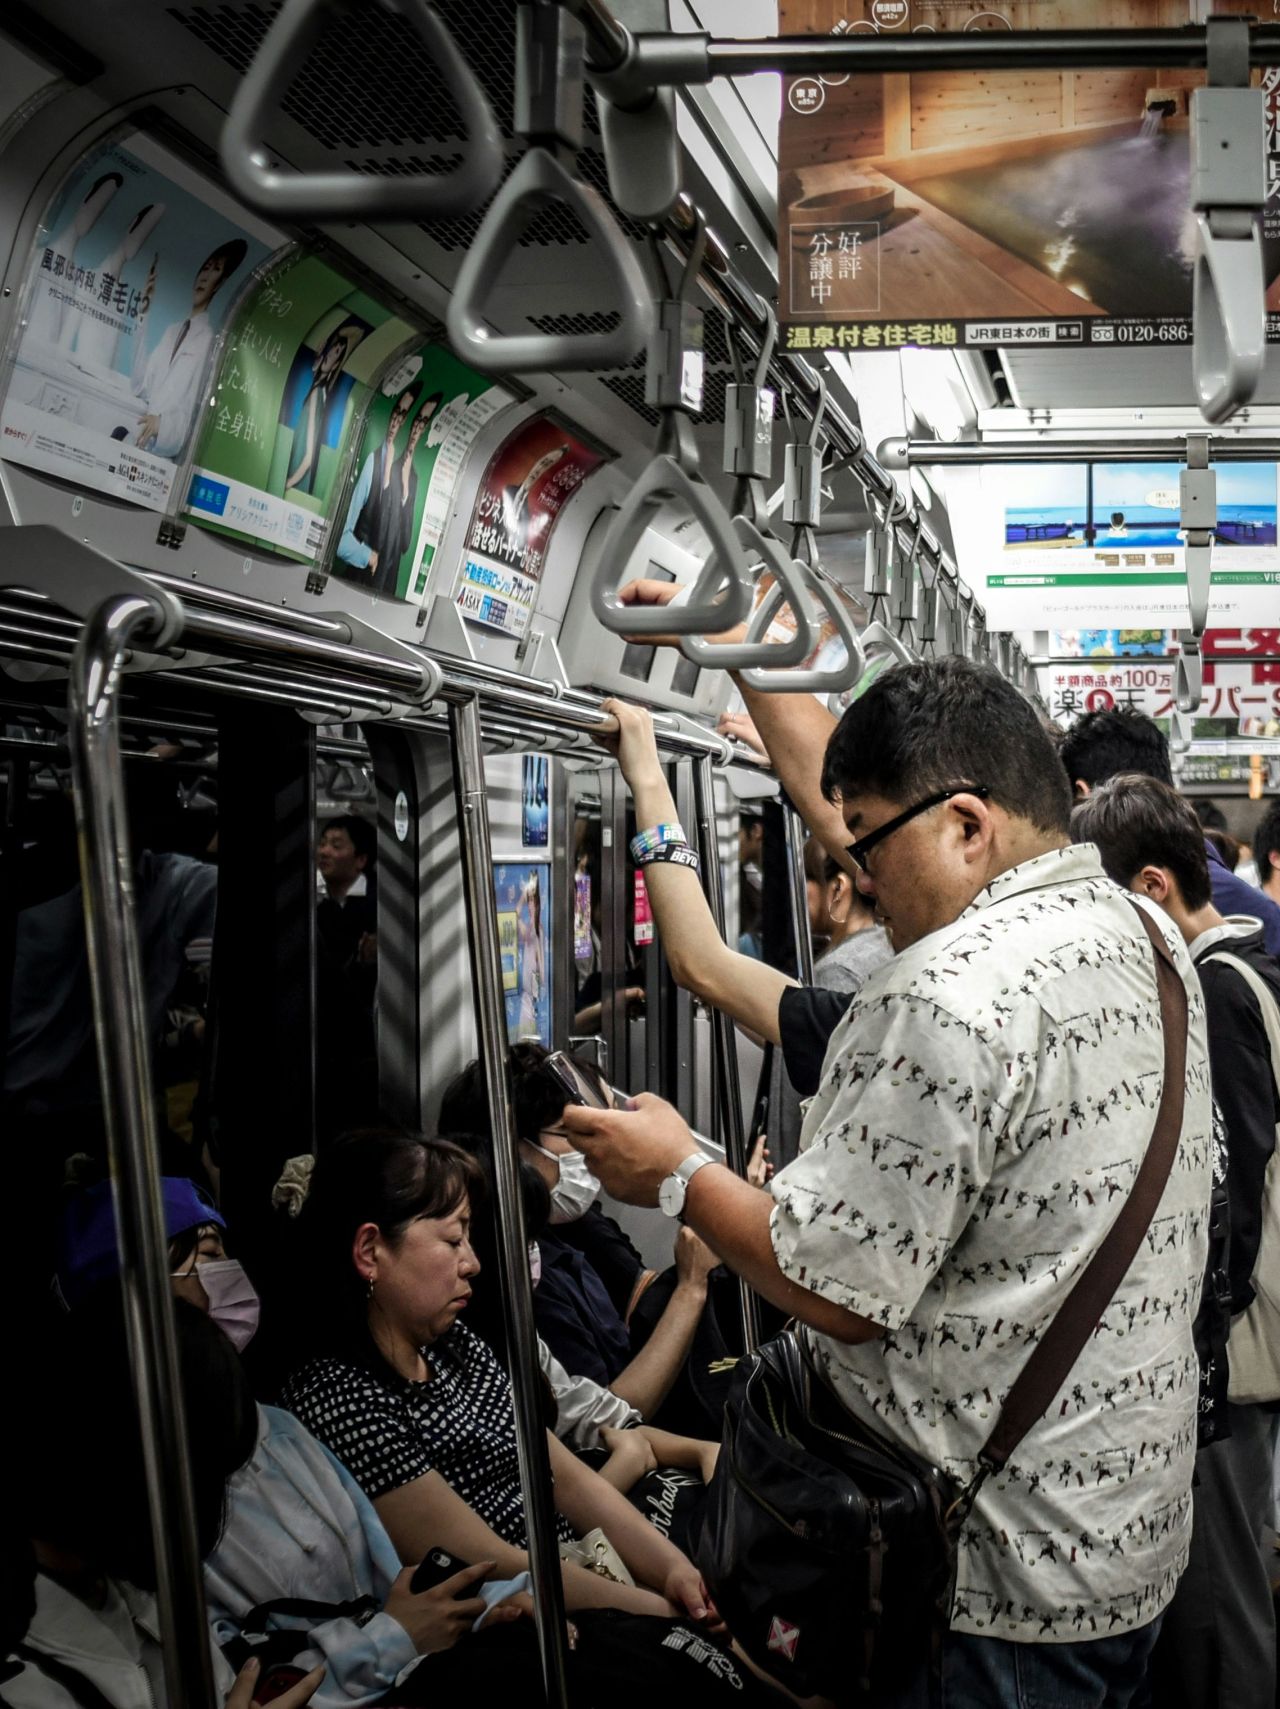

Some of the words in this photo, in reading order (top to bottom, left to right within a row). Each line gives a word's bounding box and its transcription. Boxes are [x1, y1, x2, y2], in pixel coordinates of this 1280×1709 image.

[809, 233, 834, 305] 分譲中
[838, 231, 862, 280] 好評
[786, 323, 957, 348] 温泉付き住宅地
[969, 325, 1051, 340] JR東日本の街
